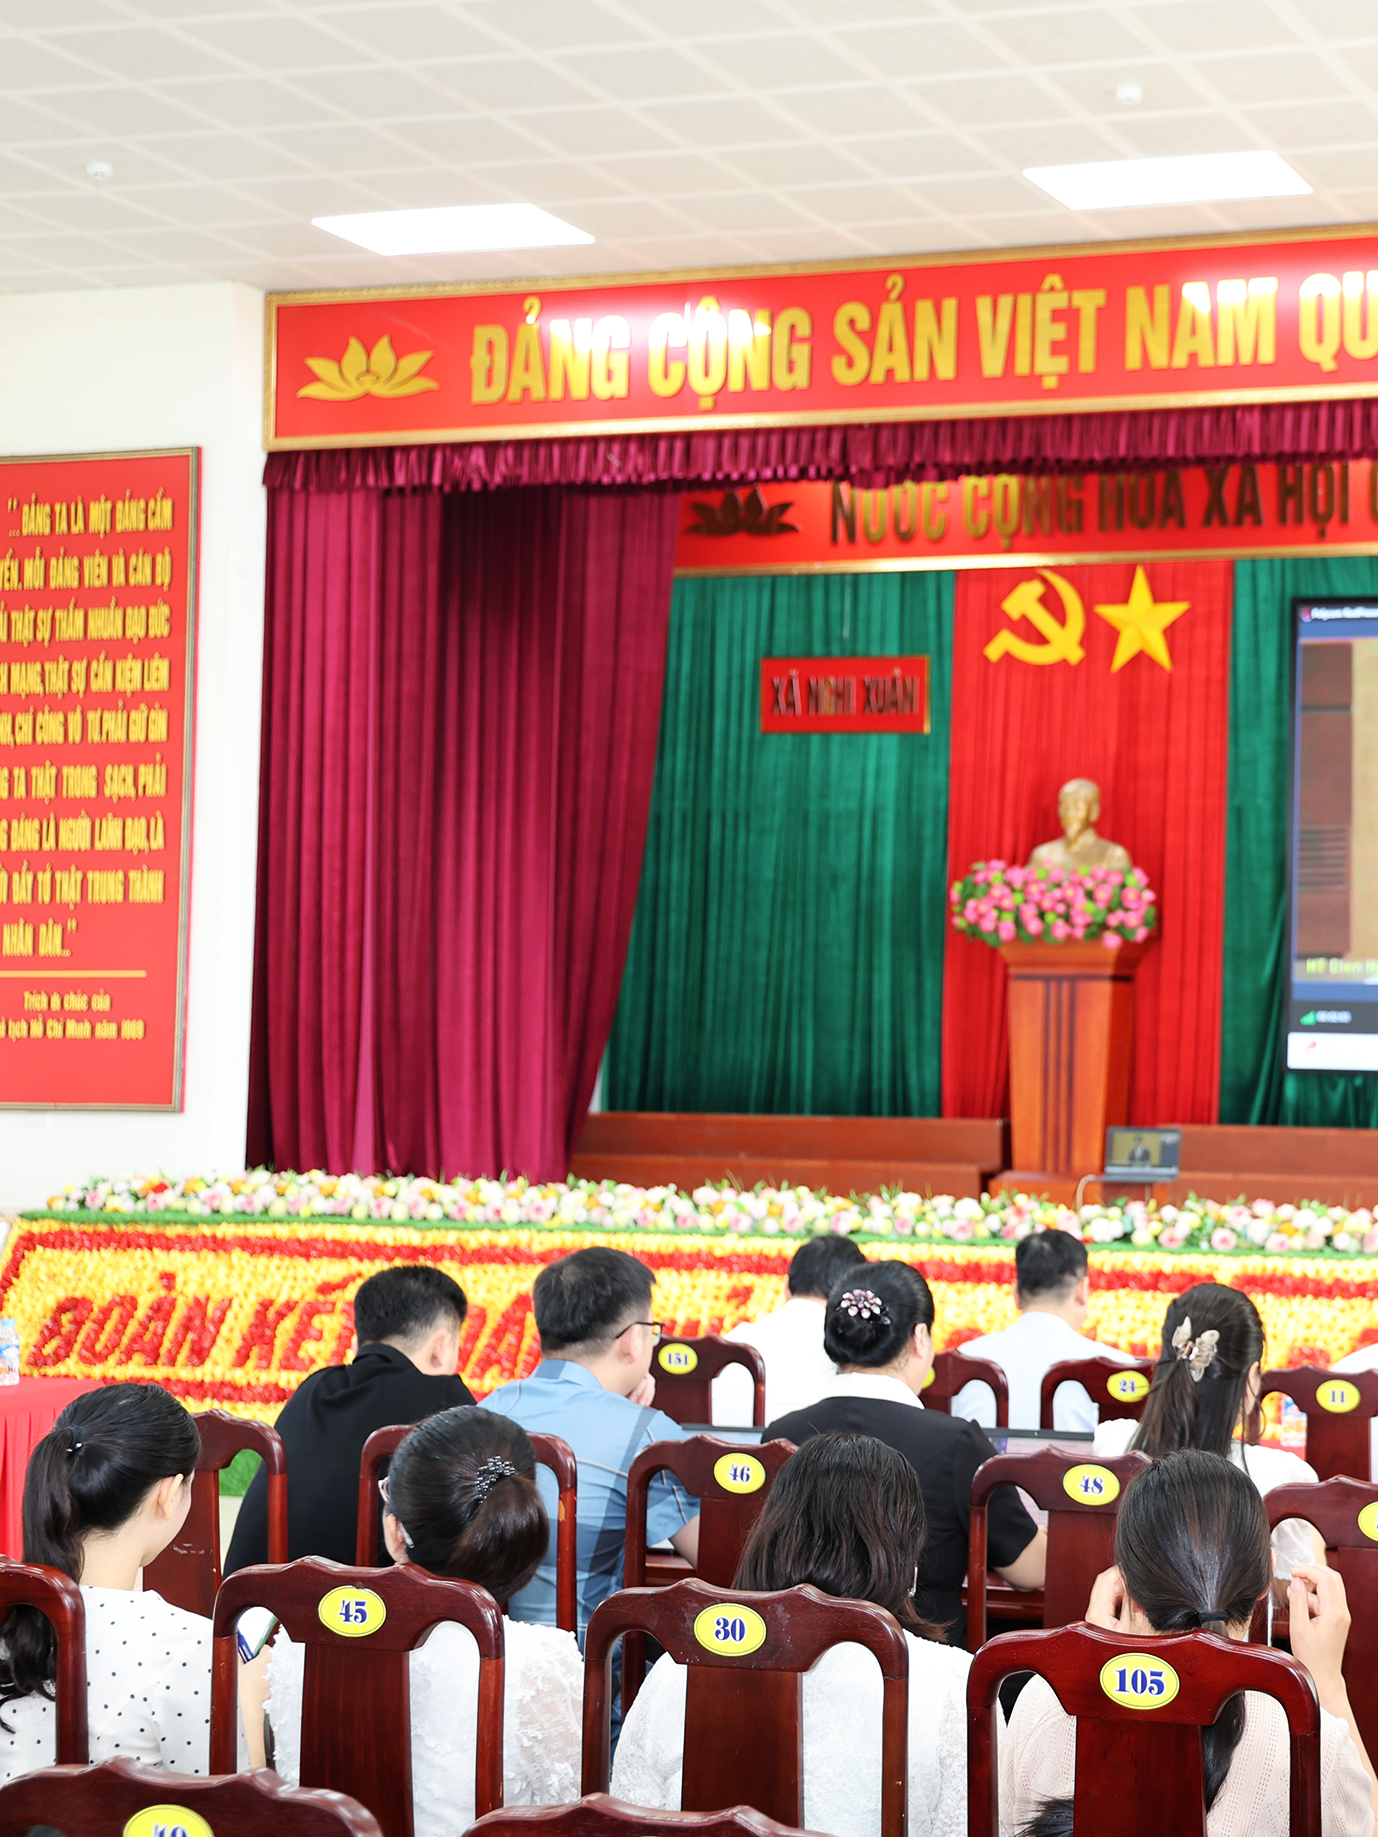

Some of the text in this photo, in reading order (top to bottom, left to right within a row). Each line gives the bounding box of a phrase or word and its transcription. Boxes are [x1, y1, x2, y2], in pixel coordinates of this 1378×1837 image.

[470, 296, 630, 404] ĐẢNG
[647, 295, 812, 410] CỘNG
[832, 273, 957, 386] SẢN
[976, 273, 1106, 390] VIỆT
[1124, 276, 1278, 371] NAM
[667, 1352, 688, 1366] 151
[1328, 1388, 1347, 1403] 11
[729, 1465, 750, 1483] 46
[1080, 1476, 1104, 1495] 48
[338, 1599, 368, 1624] 45
[714, 1616, 746, 1643] 30
[1115, 1668, 1165, 1697] 105
